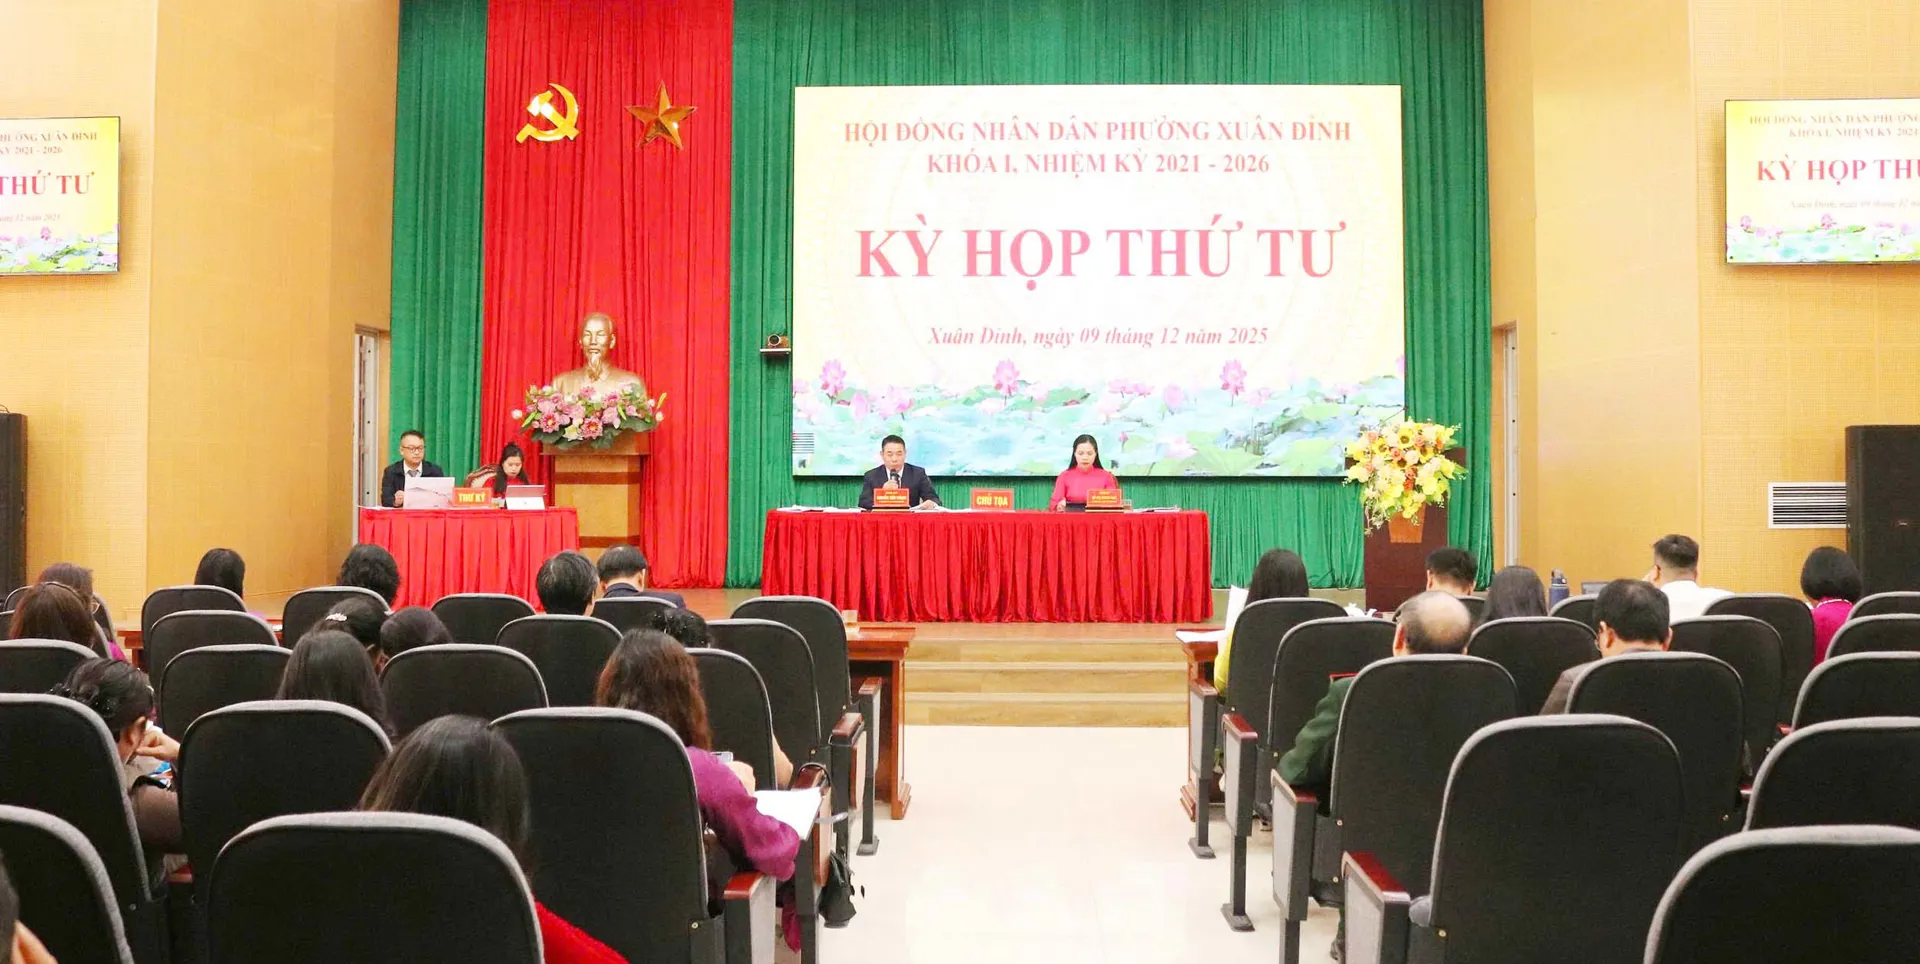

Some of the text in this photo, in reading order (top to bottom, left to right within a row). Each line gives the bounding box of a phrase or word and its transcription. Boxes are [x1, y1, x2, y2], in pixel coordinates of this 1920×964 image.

[845, 120, 887, 147] HỘI
[972, 115, 1040, 141] NHÂN
[1048, 115, 1098, 141] DÂN
[1106, 114, 1210, 141] PHƯỜNG
[1217, 114, 1283, 140] XUÂN
[928, 148, 998, 173] KHÓA
[1004, 154, 1018, 174] I,
[1026, 150, 1106, 179] NHIỆM
[1114, 148, 1148, 173] KỲ
[1155, 154, 1200, 173] 2021
[1223, 154, 1270, 173] 2026
[1757, 154, 1920, 185] KỲ HỌP TH
[56, 171, 96, 195] TƯ
[855, 214, 1347, 291] KỲ HỌP THỨ TƯ
[928, 327, 975, 344] Xuân
[1033, 327, 1075, 349] ngày
[1080, 327, 1101, 344] 09
[1105, 327, 1154, 348] tháng
[1160, 327, 1180, 344] 12
[1185, 329, 1222, 344] năm
[1228, 327, 1269, 344] 2025
